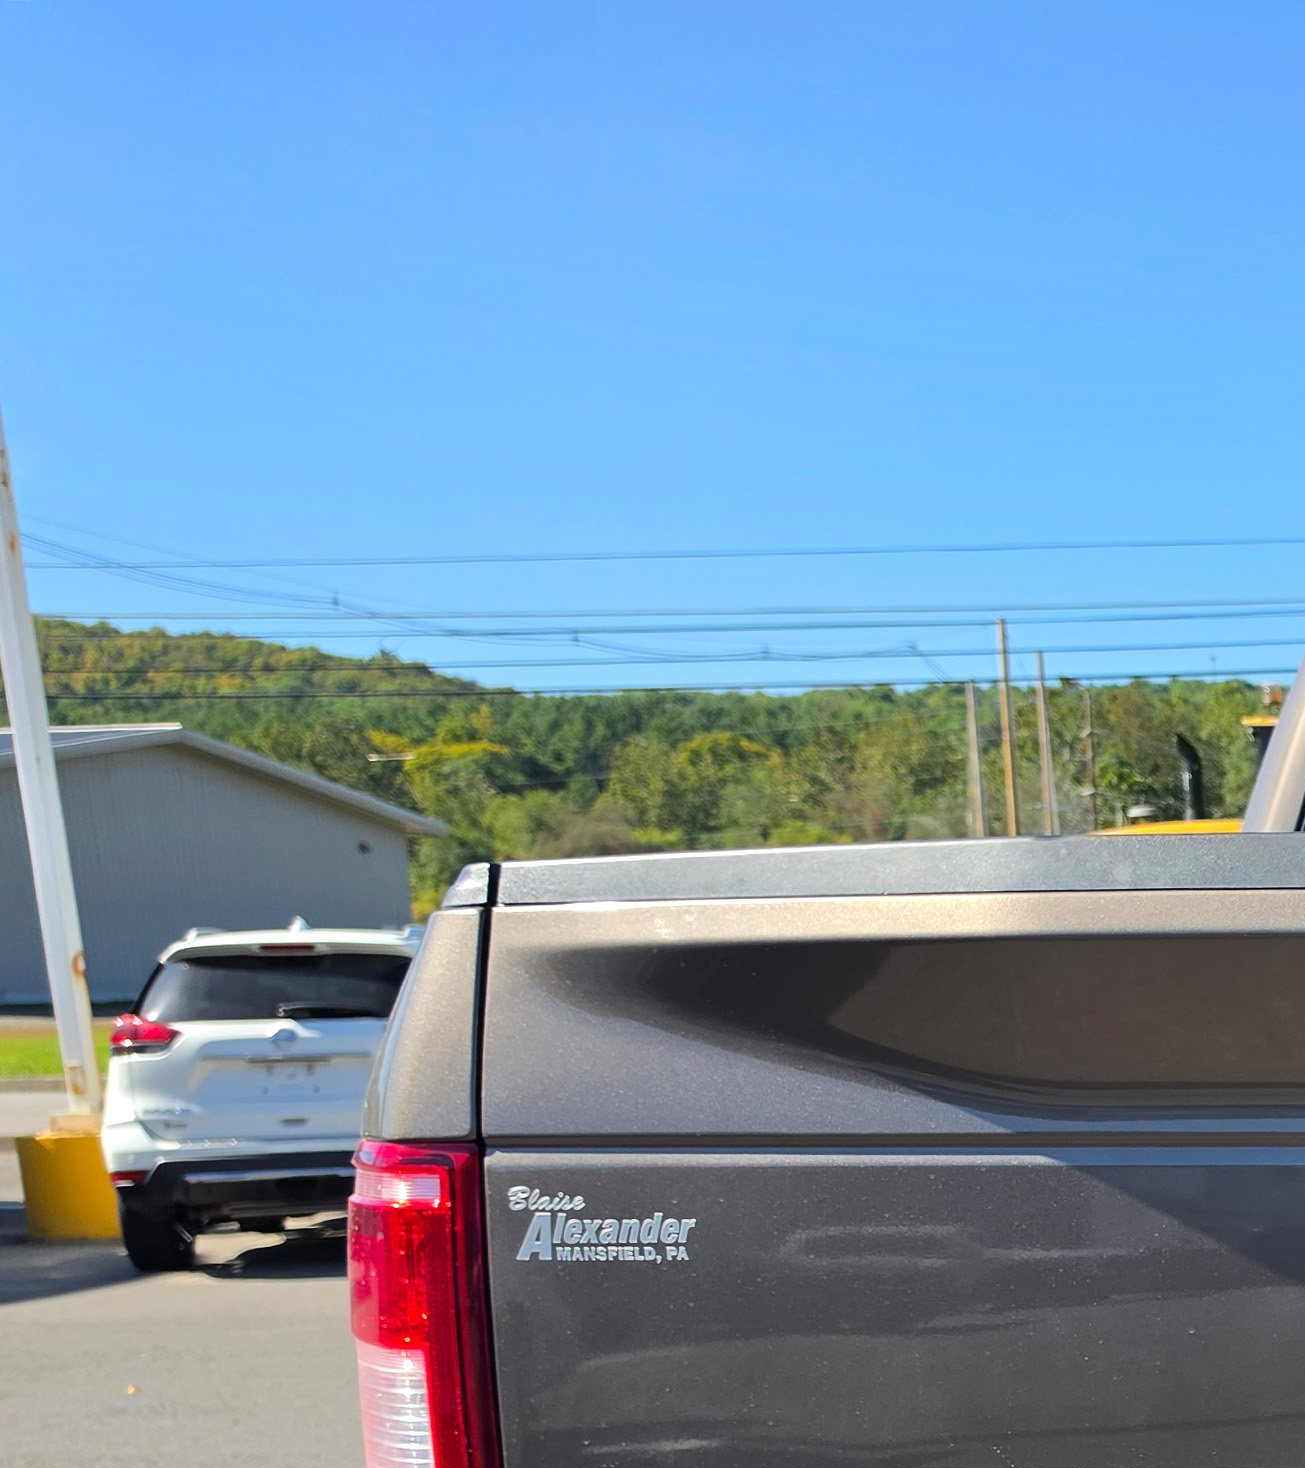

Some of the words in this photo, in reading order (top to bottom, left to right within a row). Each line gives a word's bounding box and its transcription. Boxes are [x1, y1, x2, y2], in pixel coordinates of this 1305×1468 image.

[507, 1185, 586, 1211] Blaise
[516, 1212, 697, 1261] Alexander
[556, 1246, 662, 1264] MANSFIELD,
[666, 1246, 690, 1261] PA
